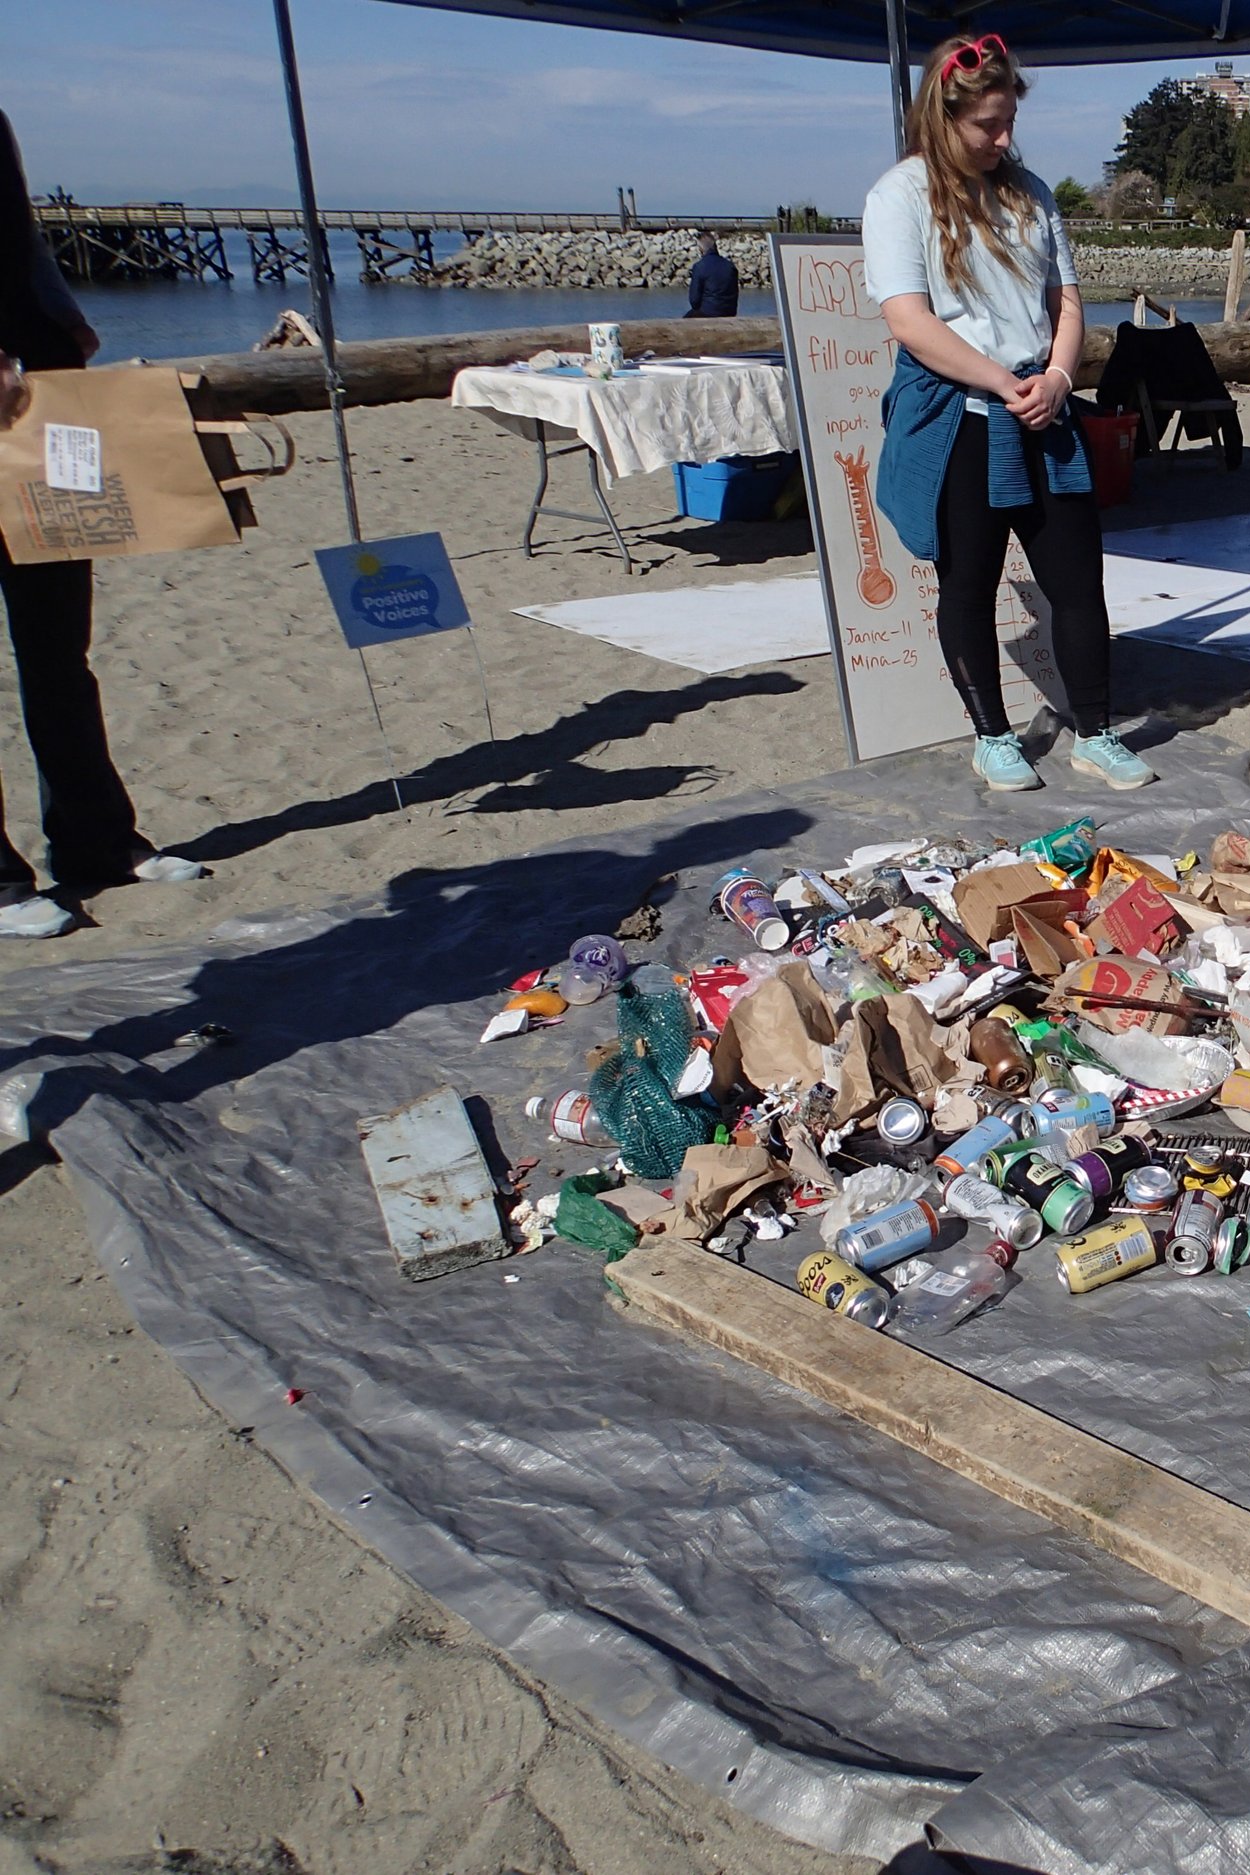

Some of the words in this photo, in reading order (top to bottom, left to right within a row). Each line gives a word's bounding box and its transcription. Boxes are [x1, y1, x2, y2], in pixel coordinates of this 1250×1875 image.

[807, 335, 839, 373] fill
[844, 348, 880, 366] our
[849, 386, 864, 403] go
[866, 386, 881, 398] to
[106, 472, 139, 541] WHERE
[1010, 561, 1024, 572] 25
[361, 588, 430, 610] Positive
[373, 604, 430, 623] Voices
[1033, 648, 1050, 662] 20
